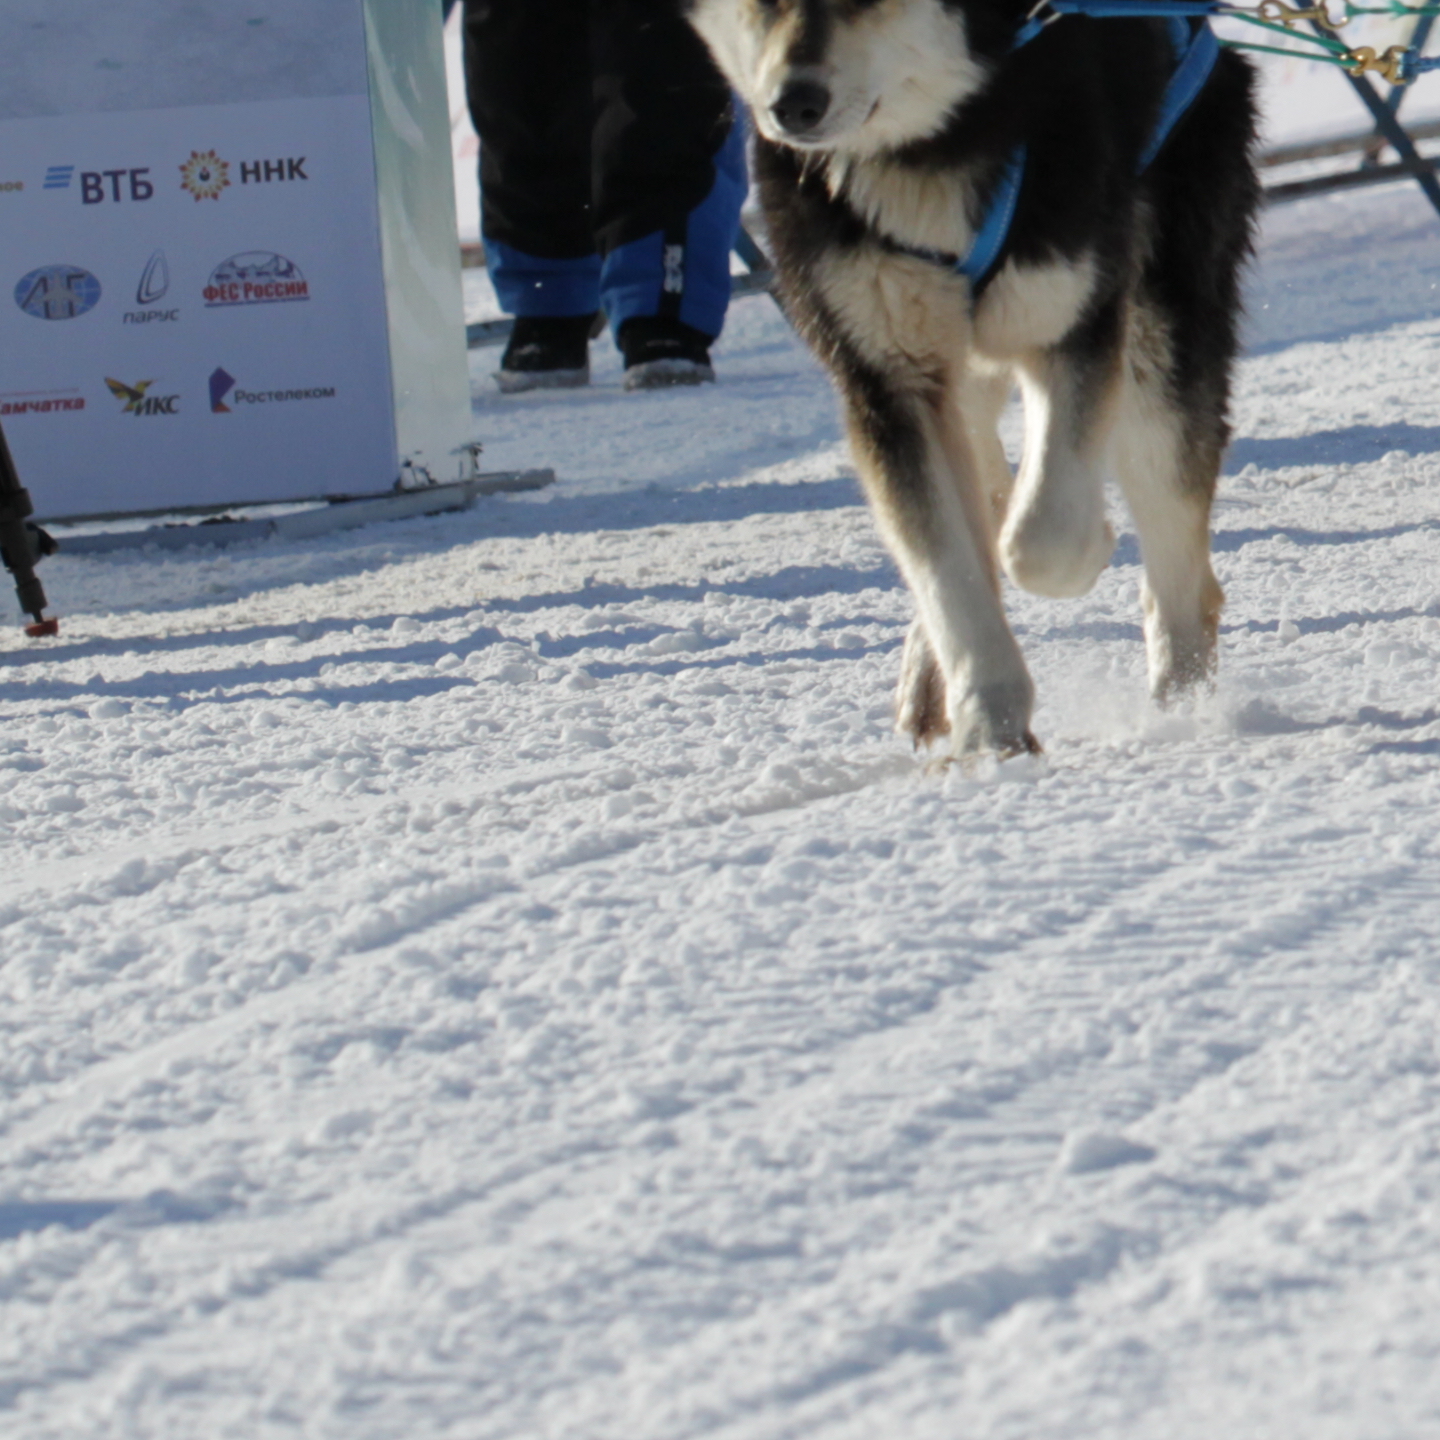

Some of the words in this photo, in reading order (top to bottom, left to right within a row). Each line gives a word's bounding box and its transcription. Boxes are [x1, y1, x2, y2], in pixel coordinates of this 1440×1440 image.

[239, 156, 309, 185] ННК
[80, 166, 154, 206] ВТБ
[202, 284, 240, 303] ФЕС
[133, 394, 181, 417] ИКС
[234, 385, 336, 405] Ростелеком
